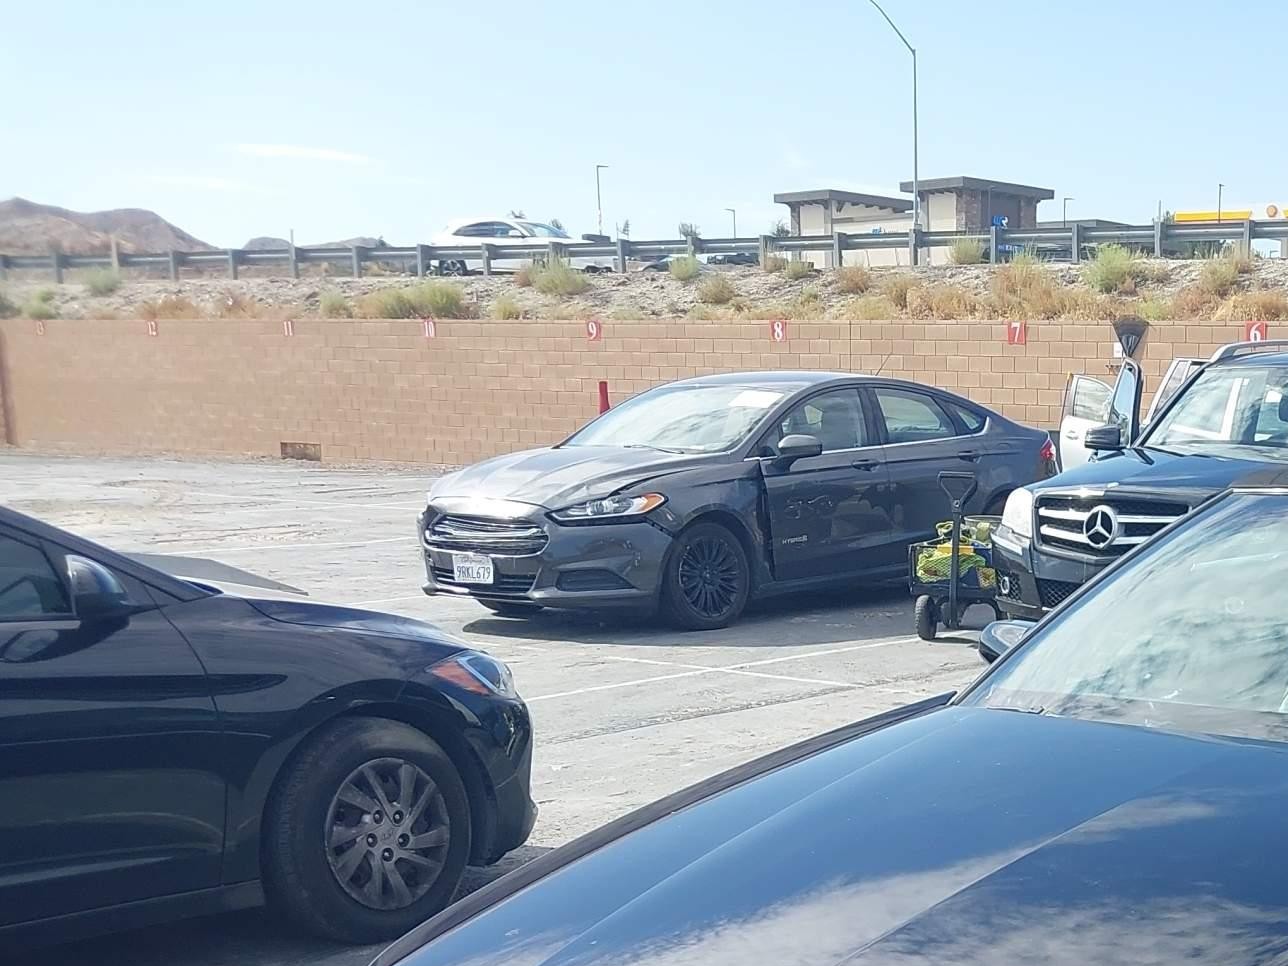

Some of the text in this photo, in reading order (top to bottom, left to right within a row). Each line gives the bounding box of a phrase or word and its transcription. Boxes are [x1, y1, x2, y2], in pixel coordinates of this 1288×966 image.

[424, 320, 436, 337] 10
[588, 321, 597, 340] 9
[773, 321, 783, 341] 8
[1011, 322, 1021, 343] 7
[1250, 322, 1261, 342] 6
